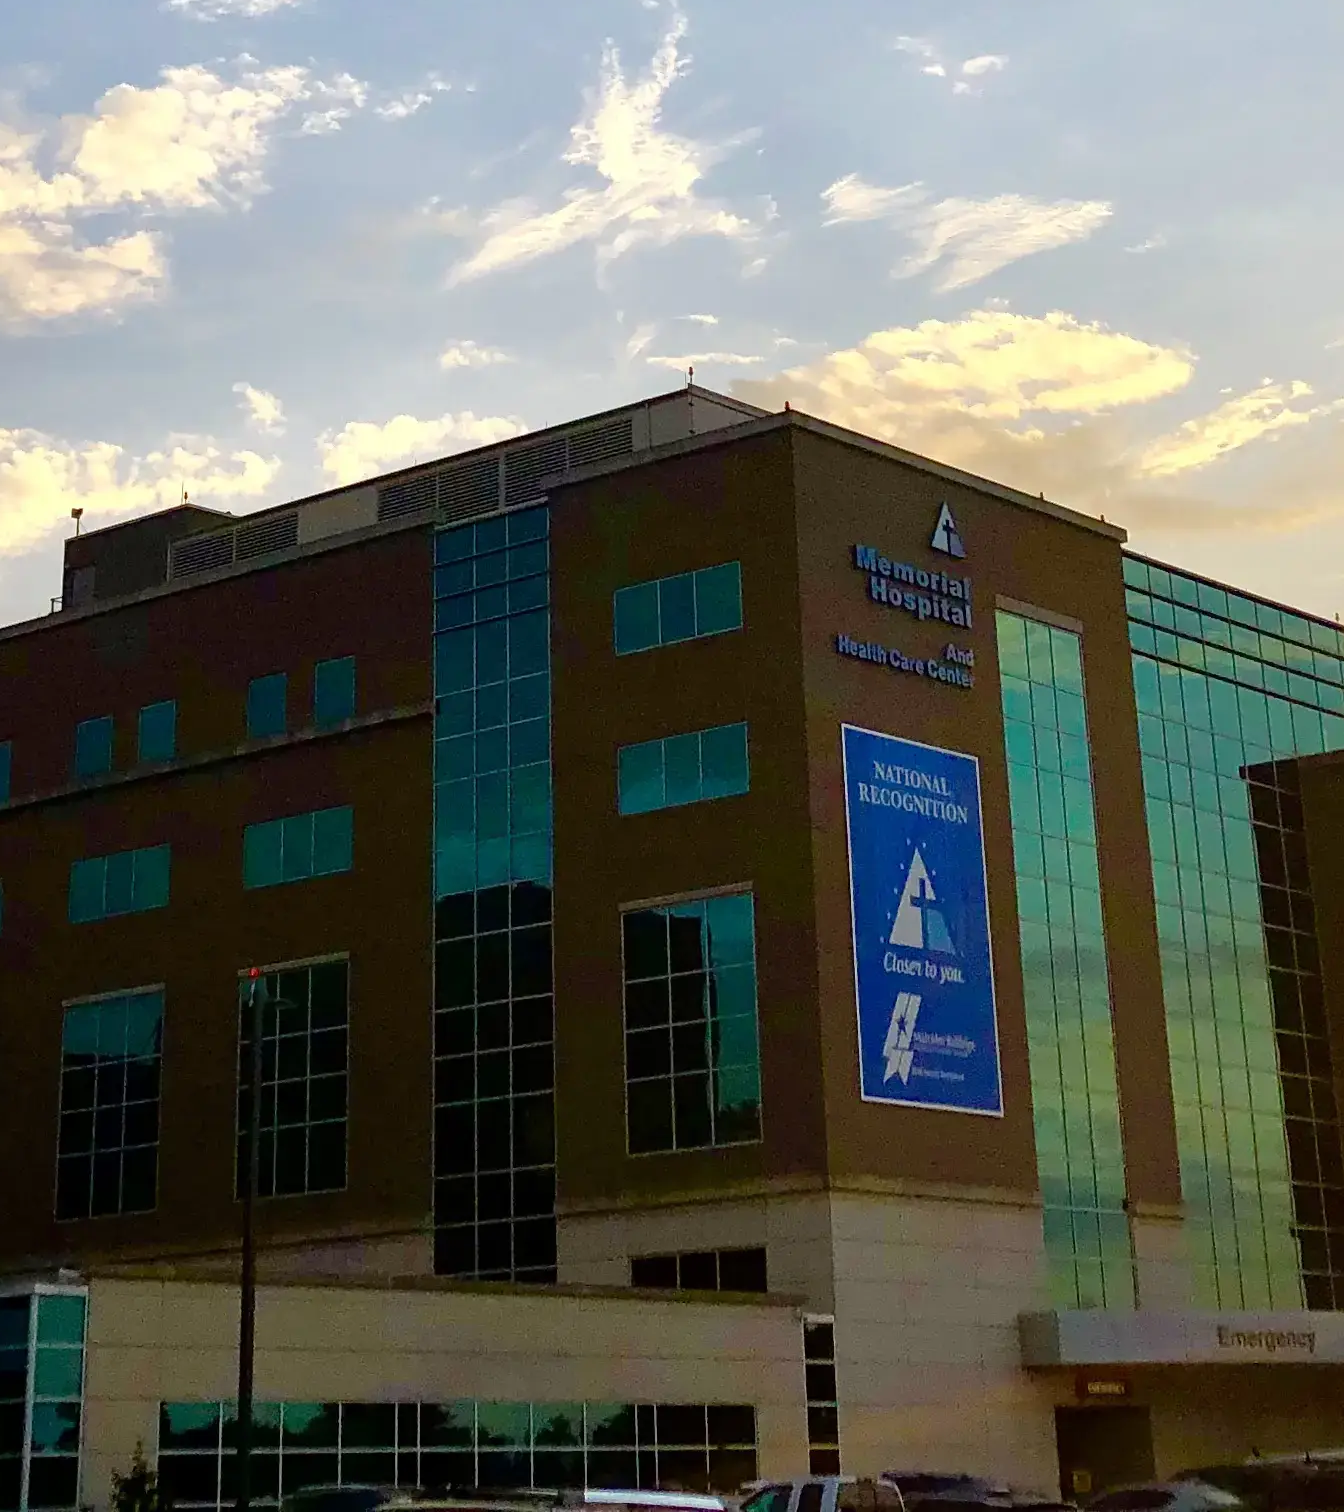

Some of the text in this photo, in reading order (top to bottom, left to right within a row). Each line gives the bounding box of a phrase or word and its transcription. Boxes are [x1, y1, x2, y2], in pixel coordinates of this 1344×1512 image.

[855, 544, 971, 600] Memorial
[870, 577, 972, 629] Hospital
[837, 635, 974, 687] Health Care Center
[946, 643, 974, 666] And
[873, 761, 951, 796] NATIONAL
[858, 783, 968, 824] RECOGNITION
[883, 951, 922, 977] Closer
[925, 959, 937, 979] to
[1216, 1324, 1316, 1354] Emergency
